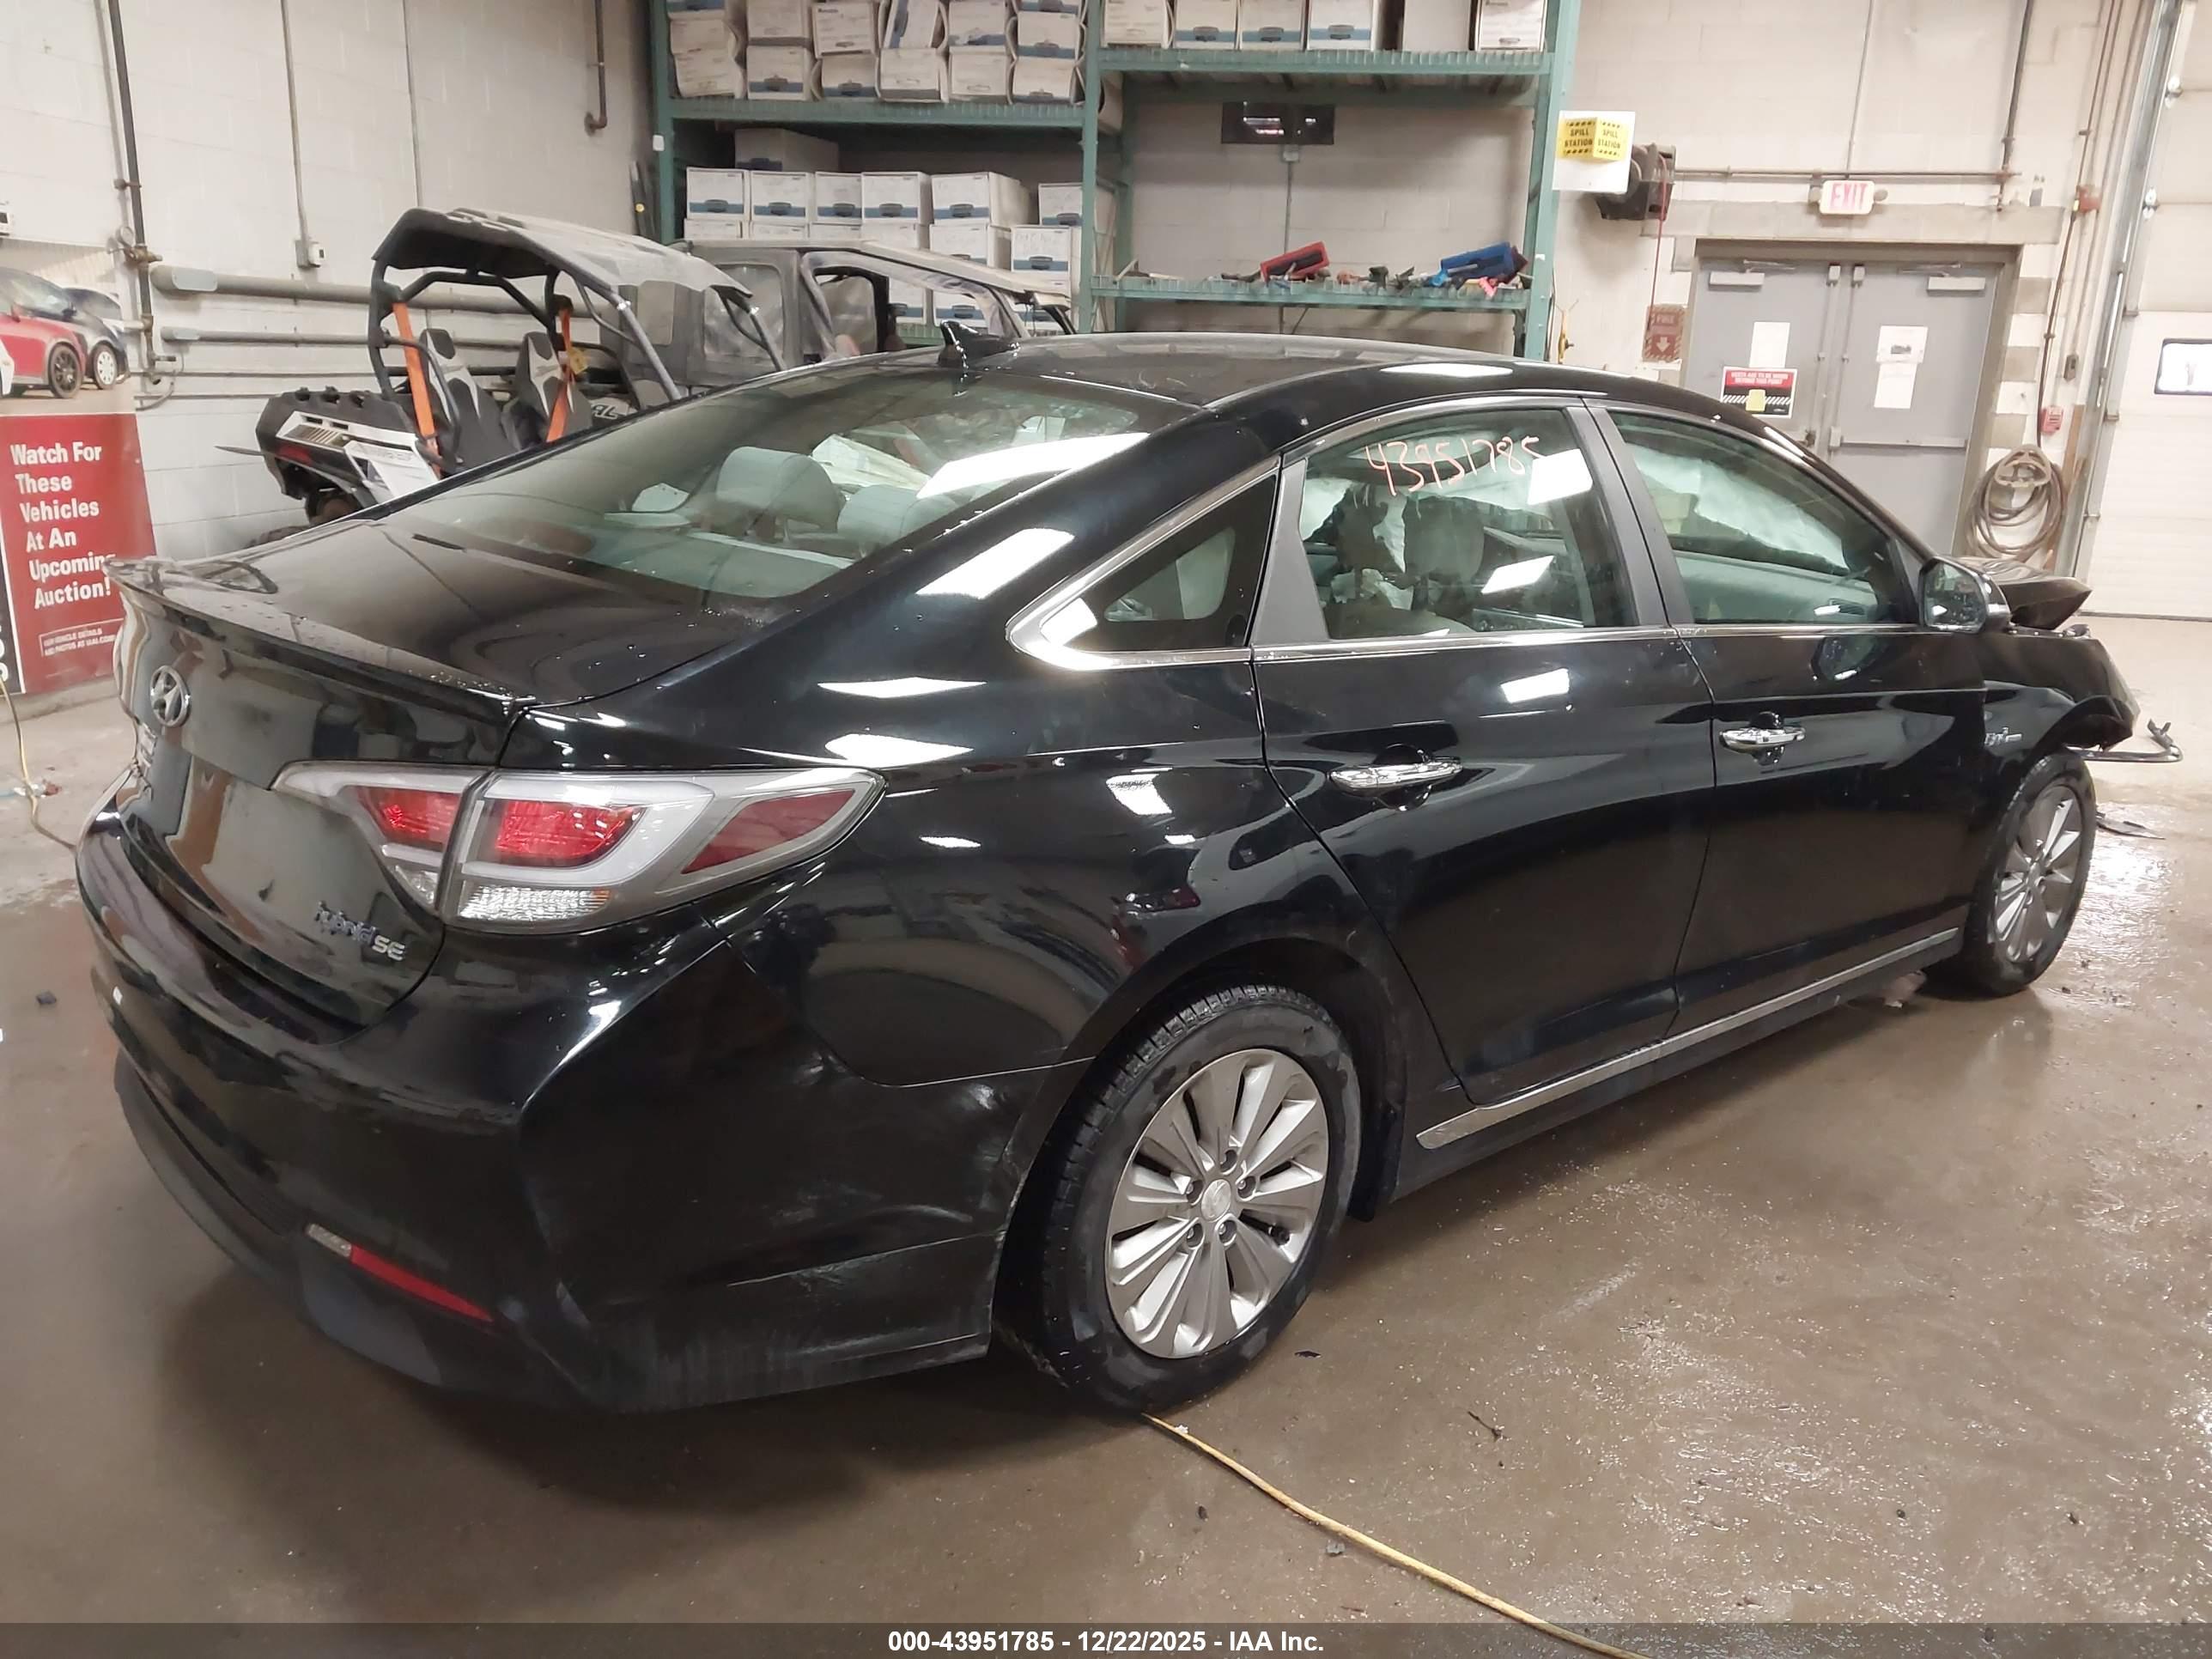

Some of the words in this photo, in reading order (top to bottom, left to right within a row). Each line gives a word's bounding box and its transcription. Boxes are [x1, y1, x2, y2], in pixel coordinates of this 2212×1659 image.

[1565, 138, 1593, 147] STATION
[1570, 128, 1589, 137] SPILL
[1597, 138, 1621, 149] STATION
[1602, 129, 1618, 138] SPILL
[1829, 182, 1868, 210] EXIT
[10, 442, 69, 465] Watch
[72, 441, 102, 462] For
[15, 472, 72, 495] These
[20, 497, 100, 523] Vehicles
[26, 531, 45, 552] At
[48, 527, 76, 549] An
[28, 551, 115, 583] Upcomin
[34, 577, 111, 610] Auction!
[372, 934, 405, 961] SE
